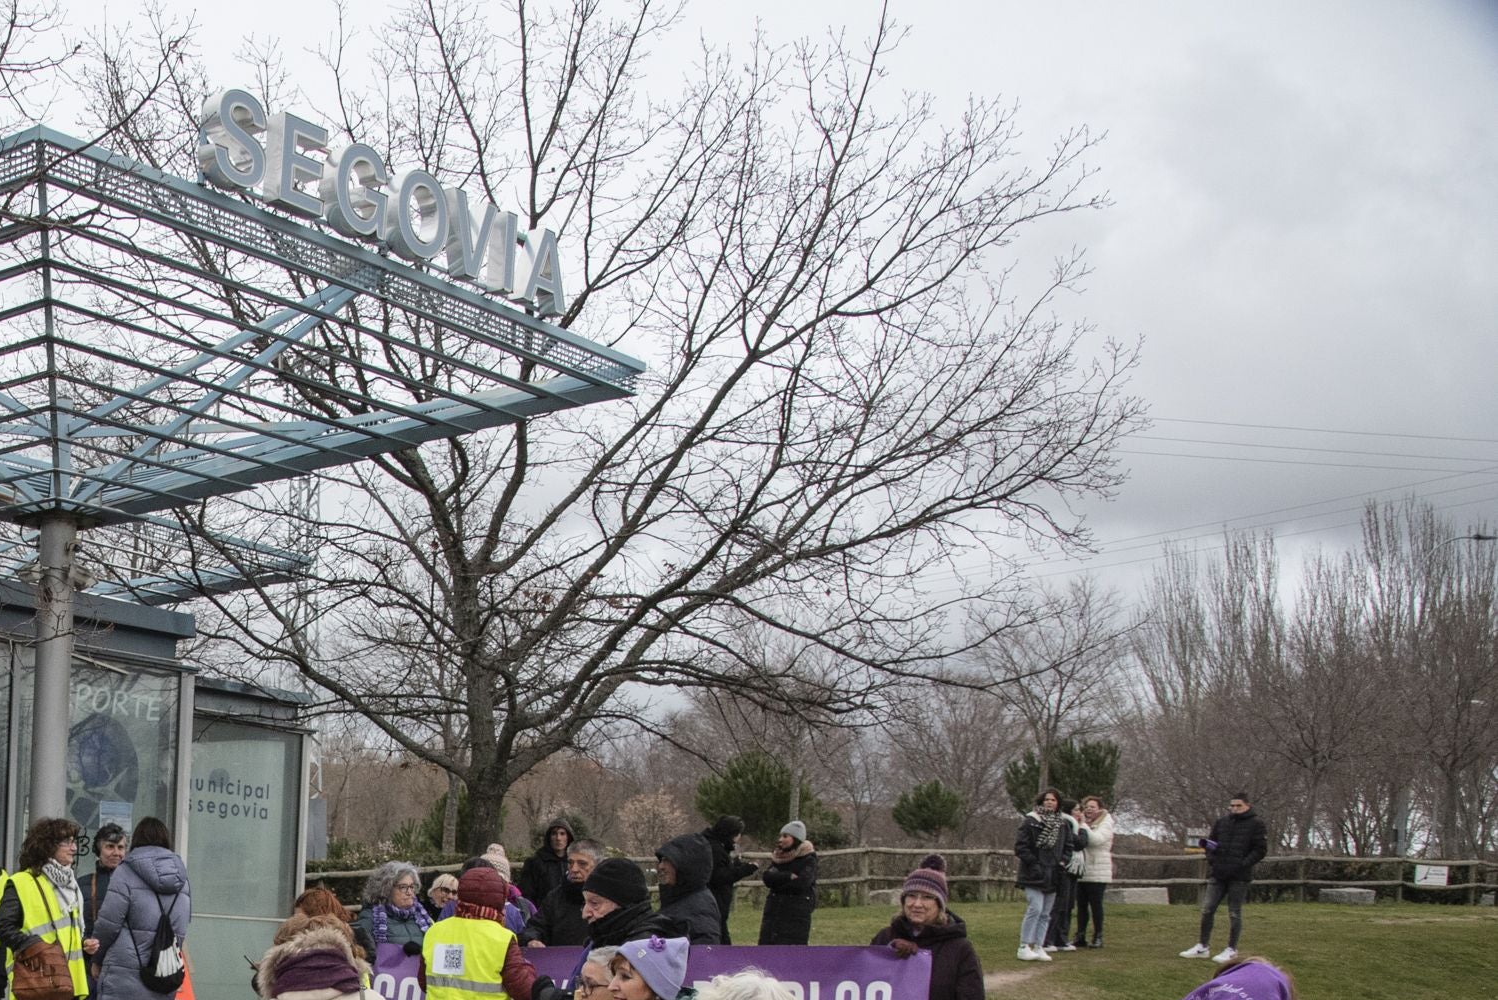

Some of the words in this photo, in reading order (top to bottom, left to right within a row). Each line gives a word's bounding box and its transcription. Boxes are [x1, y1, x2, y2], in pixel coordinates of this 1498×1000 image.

[198, 89, 565, 318] SEGOVIA
[74, 683, 162, 722] PORTE
[190, 777, 270, 800] unicipal
[197, 799, 269, 820] segovia
